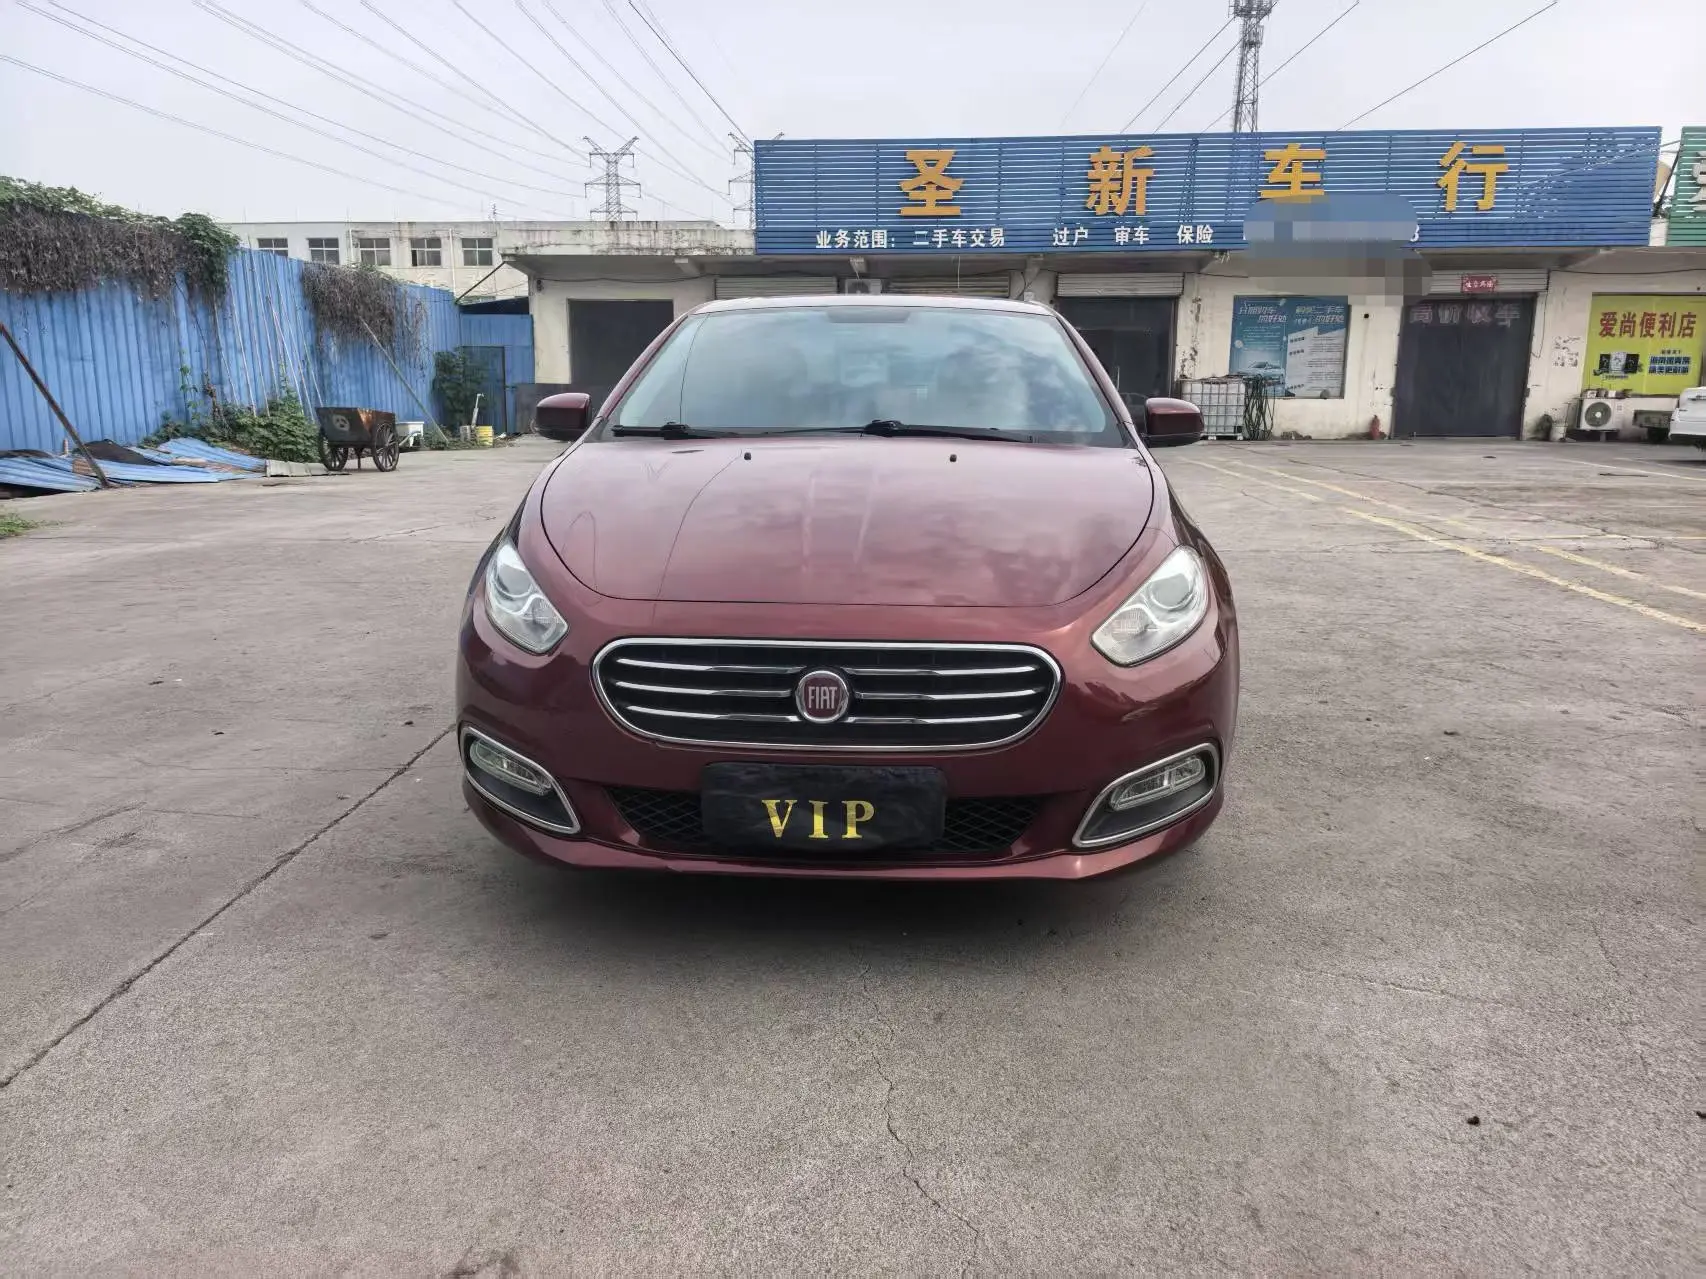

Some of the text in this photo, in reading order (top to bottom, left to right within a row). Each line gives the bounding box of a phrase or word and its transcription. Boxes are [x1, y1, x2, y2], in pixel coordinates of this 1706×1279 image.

[901, 143, 1507, 215] 圣新车行
[913, 227, 1005, 248] 二手车交易
[1052, 226, 1088, 246] 过户
[1114, 225, 1150, 245] 审车
[1176, 224, 1213, 244] 保险
[1599, 311, 1697, 338] 爱尚便利店
[808, 686, 837, 709] FIAT
[761, 799, 875, 839] VIP
